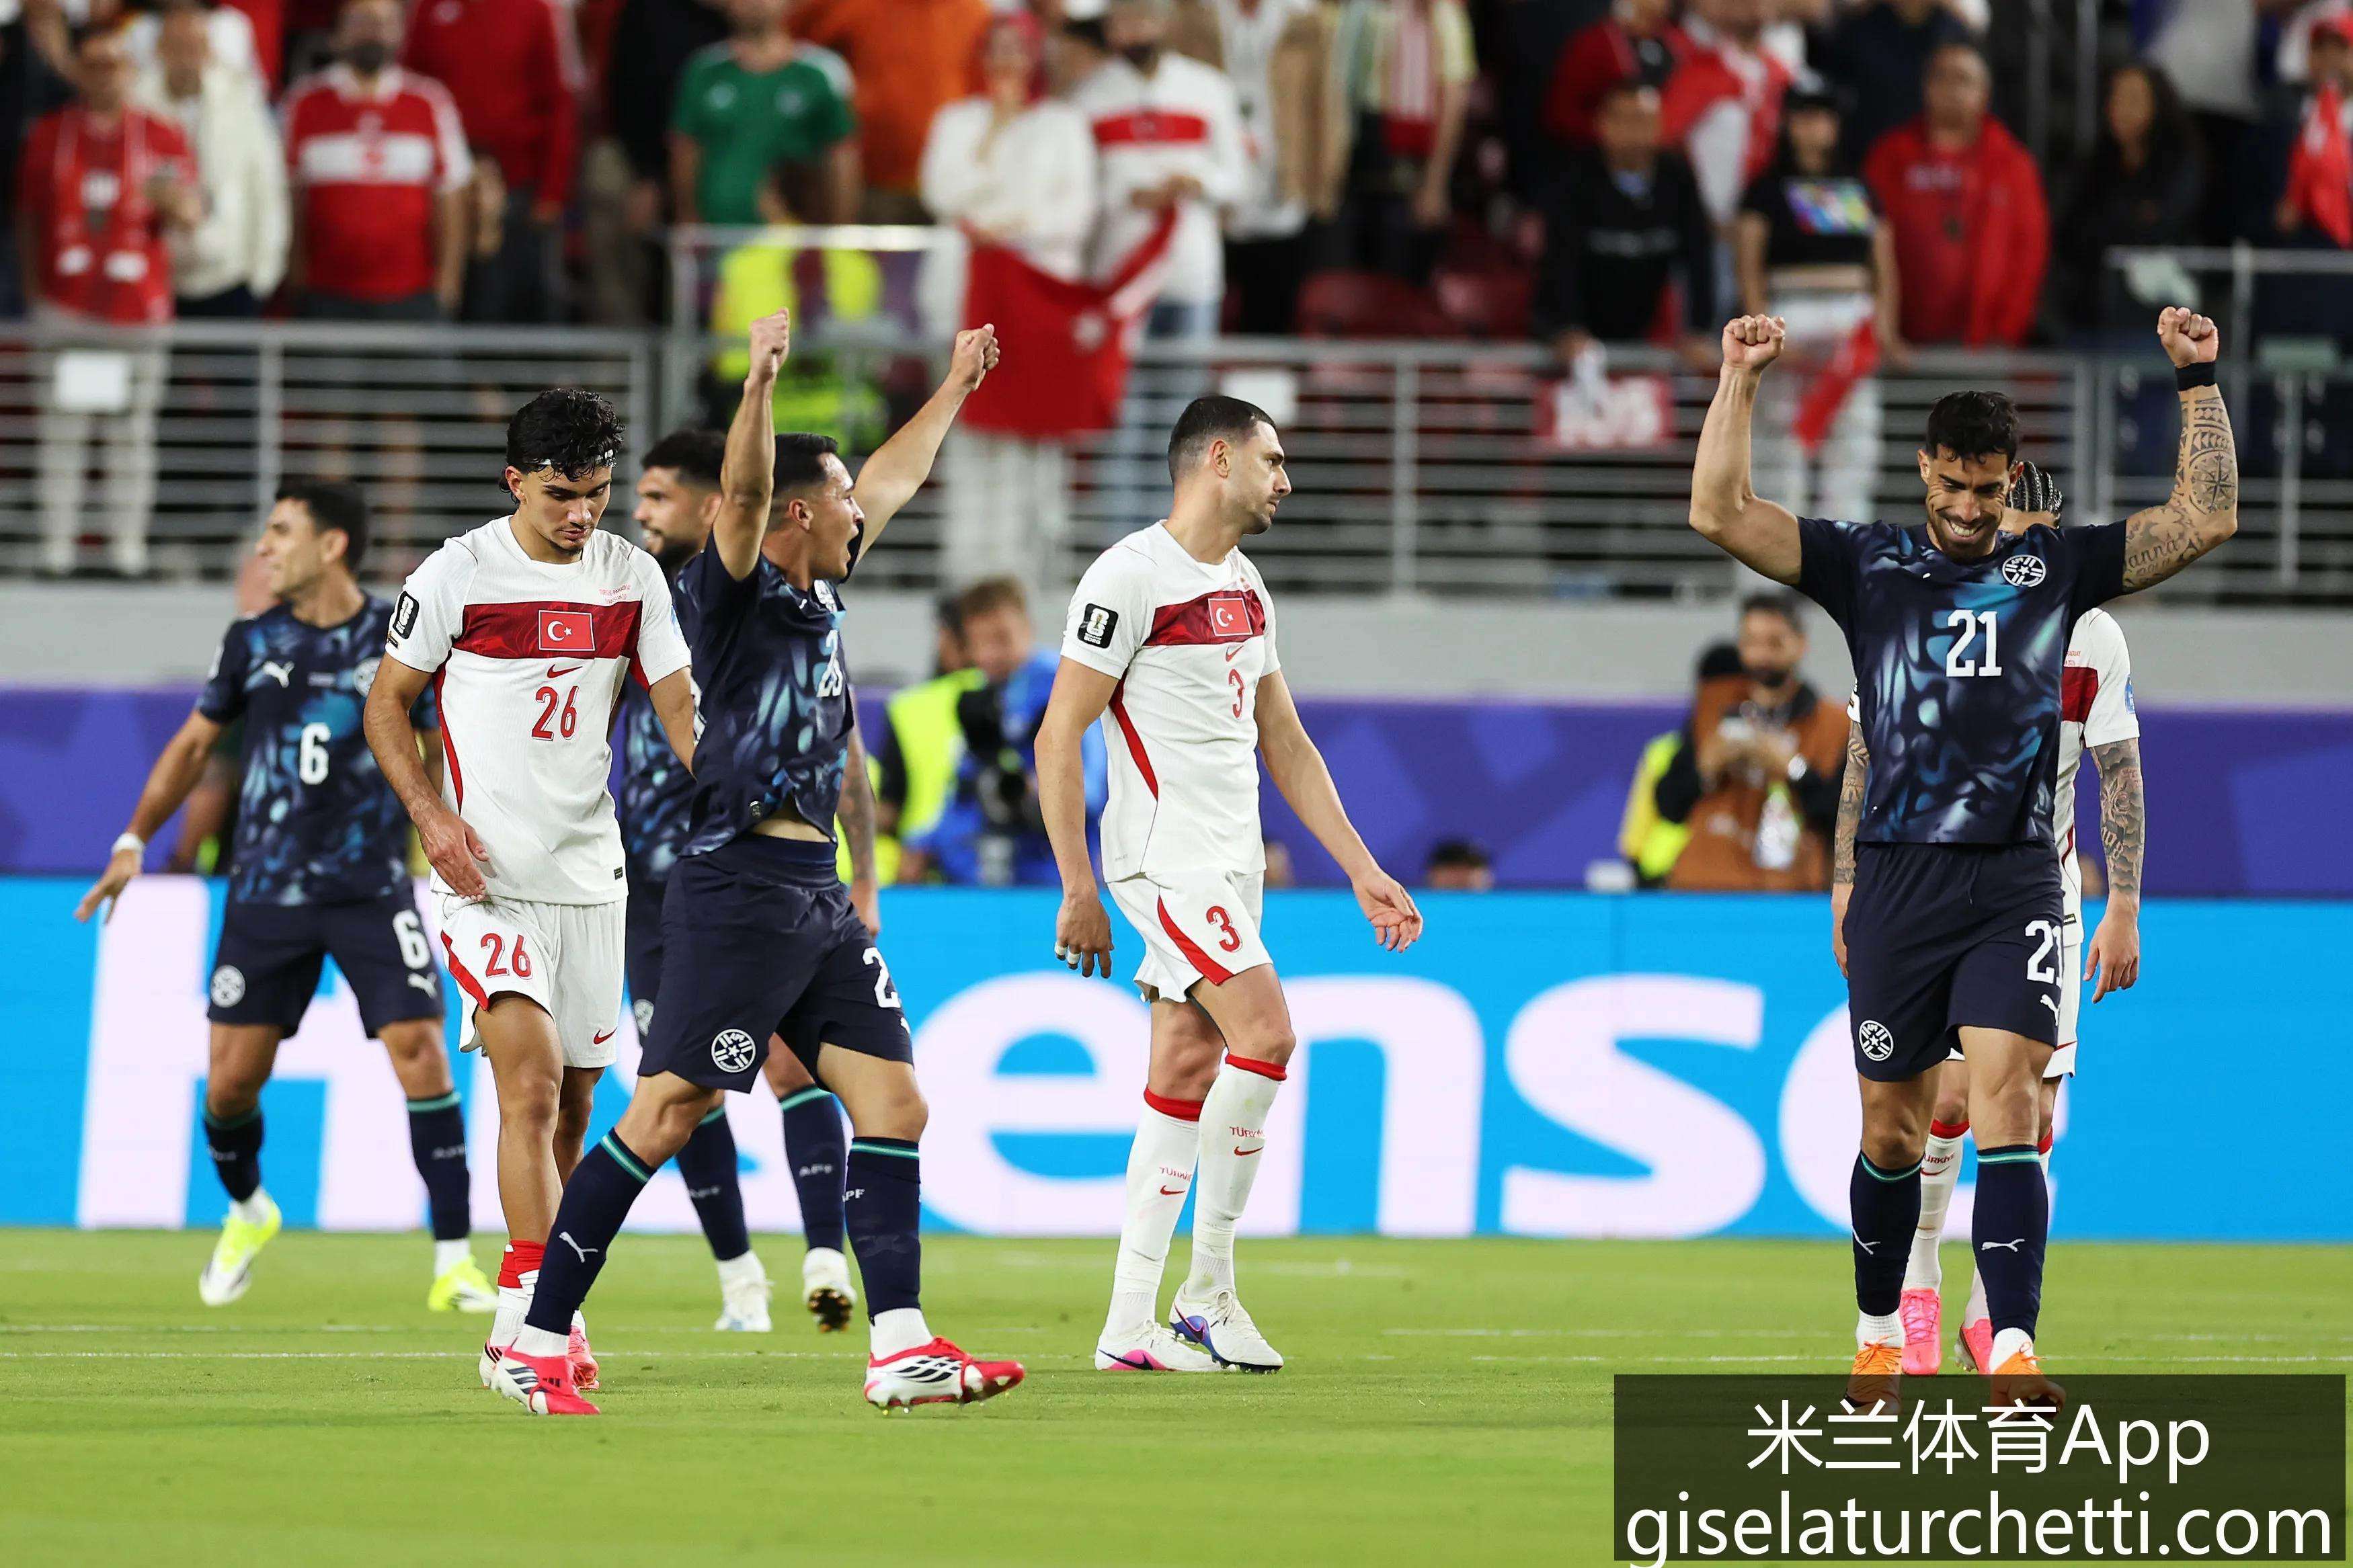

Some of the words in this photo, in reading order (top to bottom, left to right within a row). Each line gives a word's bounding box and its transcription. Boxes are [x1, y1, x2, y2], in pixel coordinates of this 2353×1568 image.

[1945, 609, 2003, 677] 21
[531, 685, 580, 742] 26
[1228, 668, 1244, 718] 3
[300, 722, 332, 785] 6
[392, 909, 431, 969] 6
[480, 932, 533, 980] 26
[1205, 905, 1242, 953] 3
[77, 874, 2069, 1237] Hens
